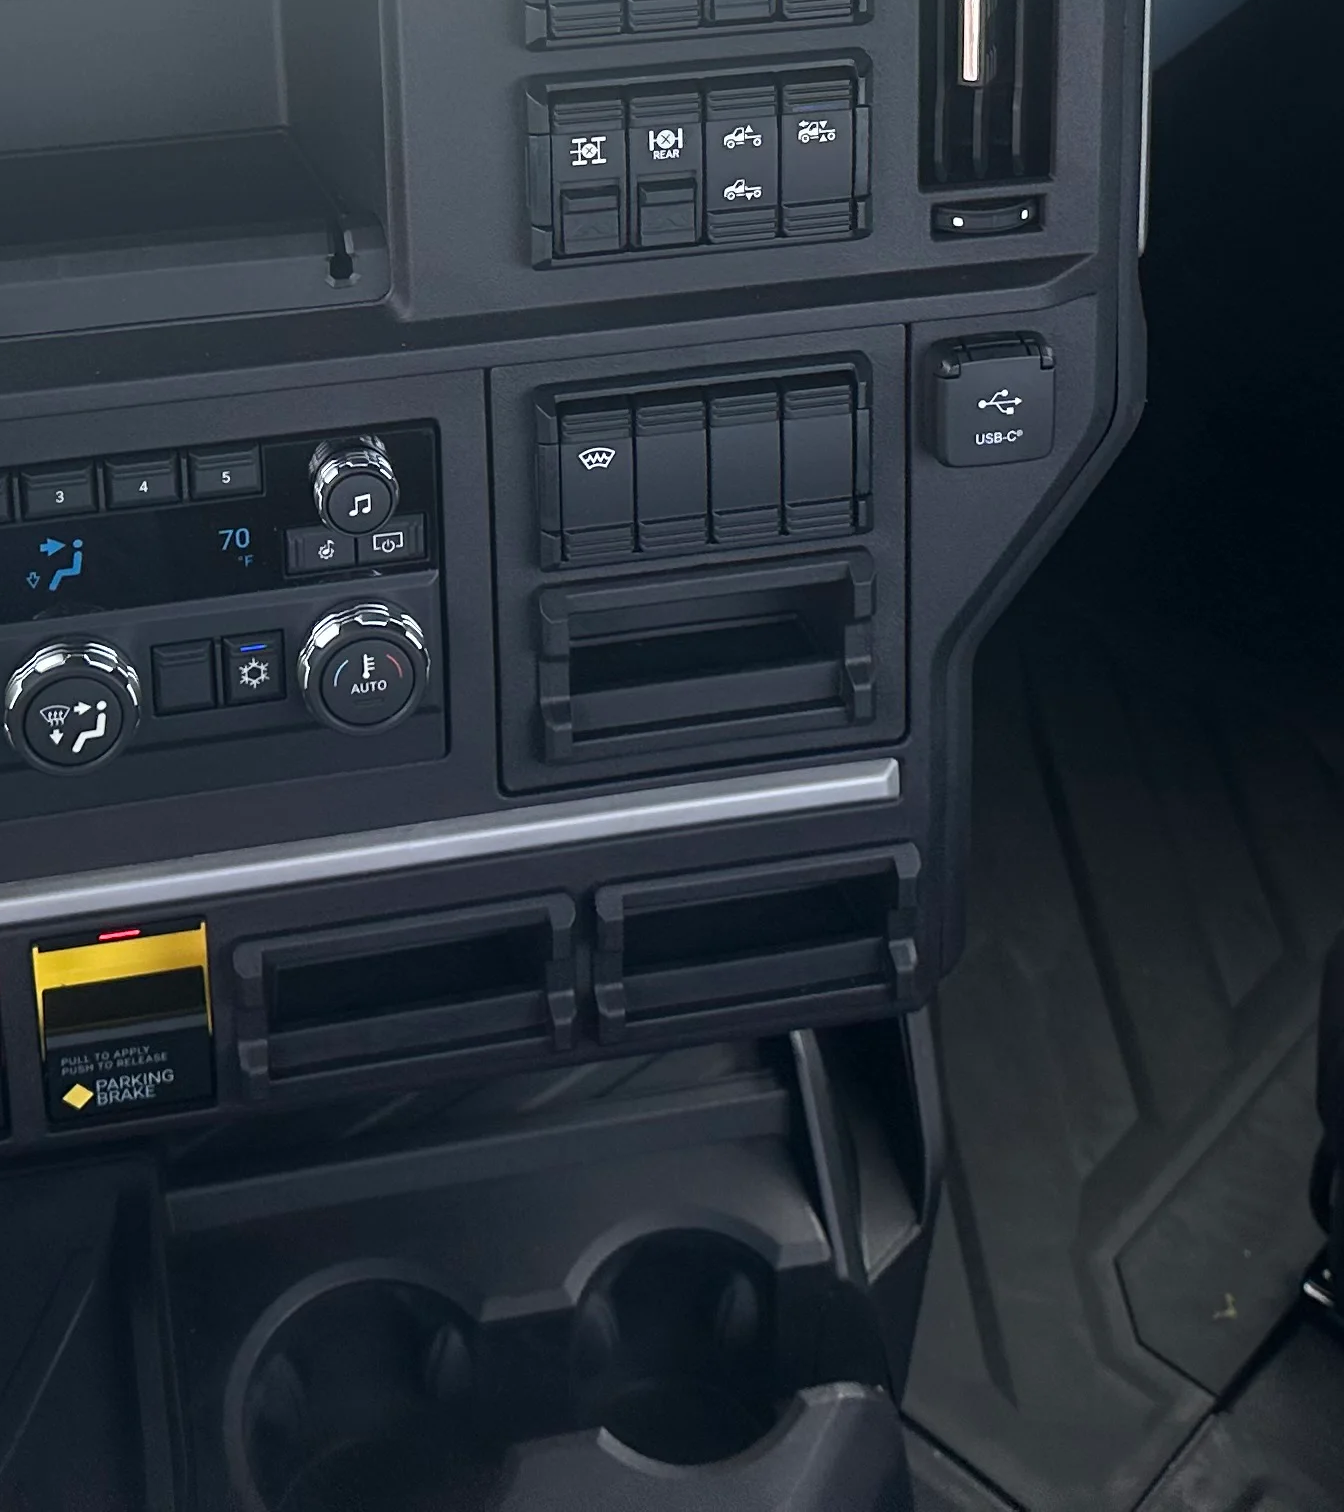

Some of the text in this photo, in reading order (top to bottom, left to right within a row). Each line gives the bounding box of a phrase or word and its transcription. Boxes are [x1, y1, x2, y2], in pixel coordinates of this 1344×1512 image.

[653, 149, 680, 160] REAR
[139, 480, 149, 493] 4
[221, 471, 231, 484] 5
[55, 490, 65, 504] 3
[218, 528, 251, 551] 70
[351, 680, 387, 695] AUTO
[61, 1046, 150, 1067] PULL TO APPLY
[62, 1052, 168, 1076] PUSH TO RELEASE
[96, 1069, 175, 1092] PARKING
[97, 1084, 156, 1106] BRAKE
